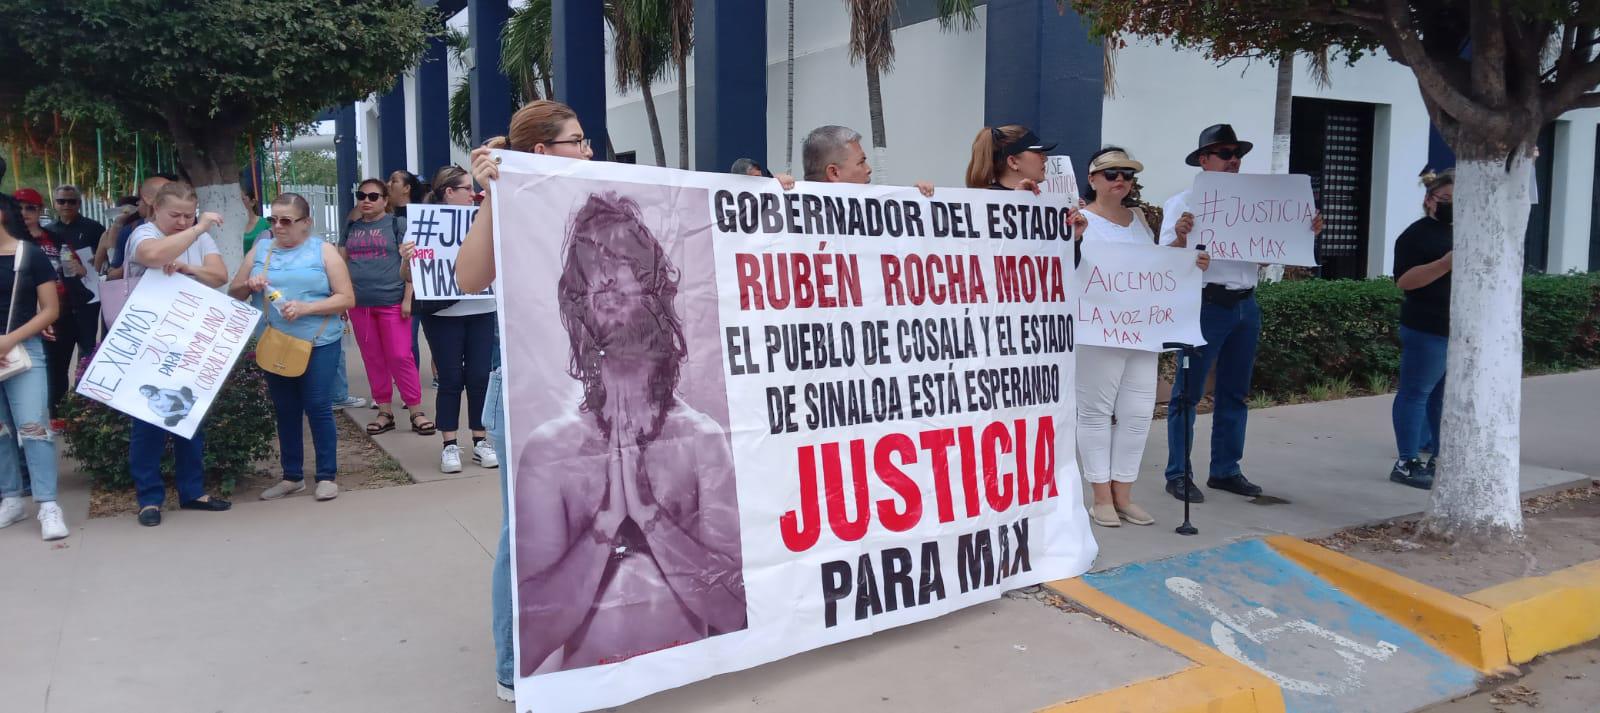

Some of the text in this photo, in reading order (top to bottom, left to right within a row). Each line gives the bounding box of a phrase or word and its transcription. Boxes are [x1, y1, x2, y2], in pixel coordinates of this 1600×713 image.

[714, 189, 1073, 241] GOBERNADOR DEL ESTADO
[1196, 190, 1313, 227] #JUSTICIA
[1200, 229, 1286, 259] PARA MAX
[735, 241, 1066, 311] RUBÉN ROCHA MOYA
[139, 291, 203, 365] JUSTICIA
[178, 306, 226, 373] MAXIMILIANO
[1078, 297, 1175, 326] LA VOZ POR
[1103, 328, 1142, 344] MAX
[158, 351, 183, 376] PARA
[195, 343, 233, 391] CORRALES
[725, 308, 1074, 375] EL PUEBLO DE COSALÁ Y EL ESTADO
[766, 363, 1060, 435] DE SINALOA ESTÁ ESPERANDO
[779, 415, 1059, 553] JUSTICIA
[820, 517, 1032, 628] PARA MAX
